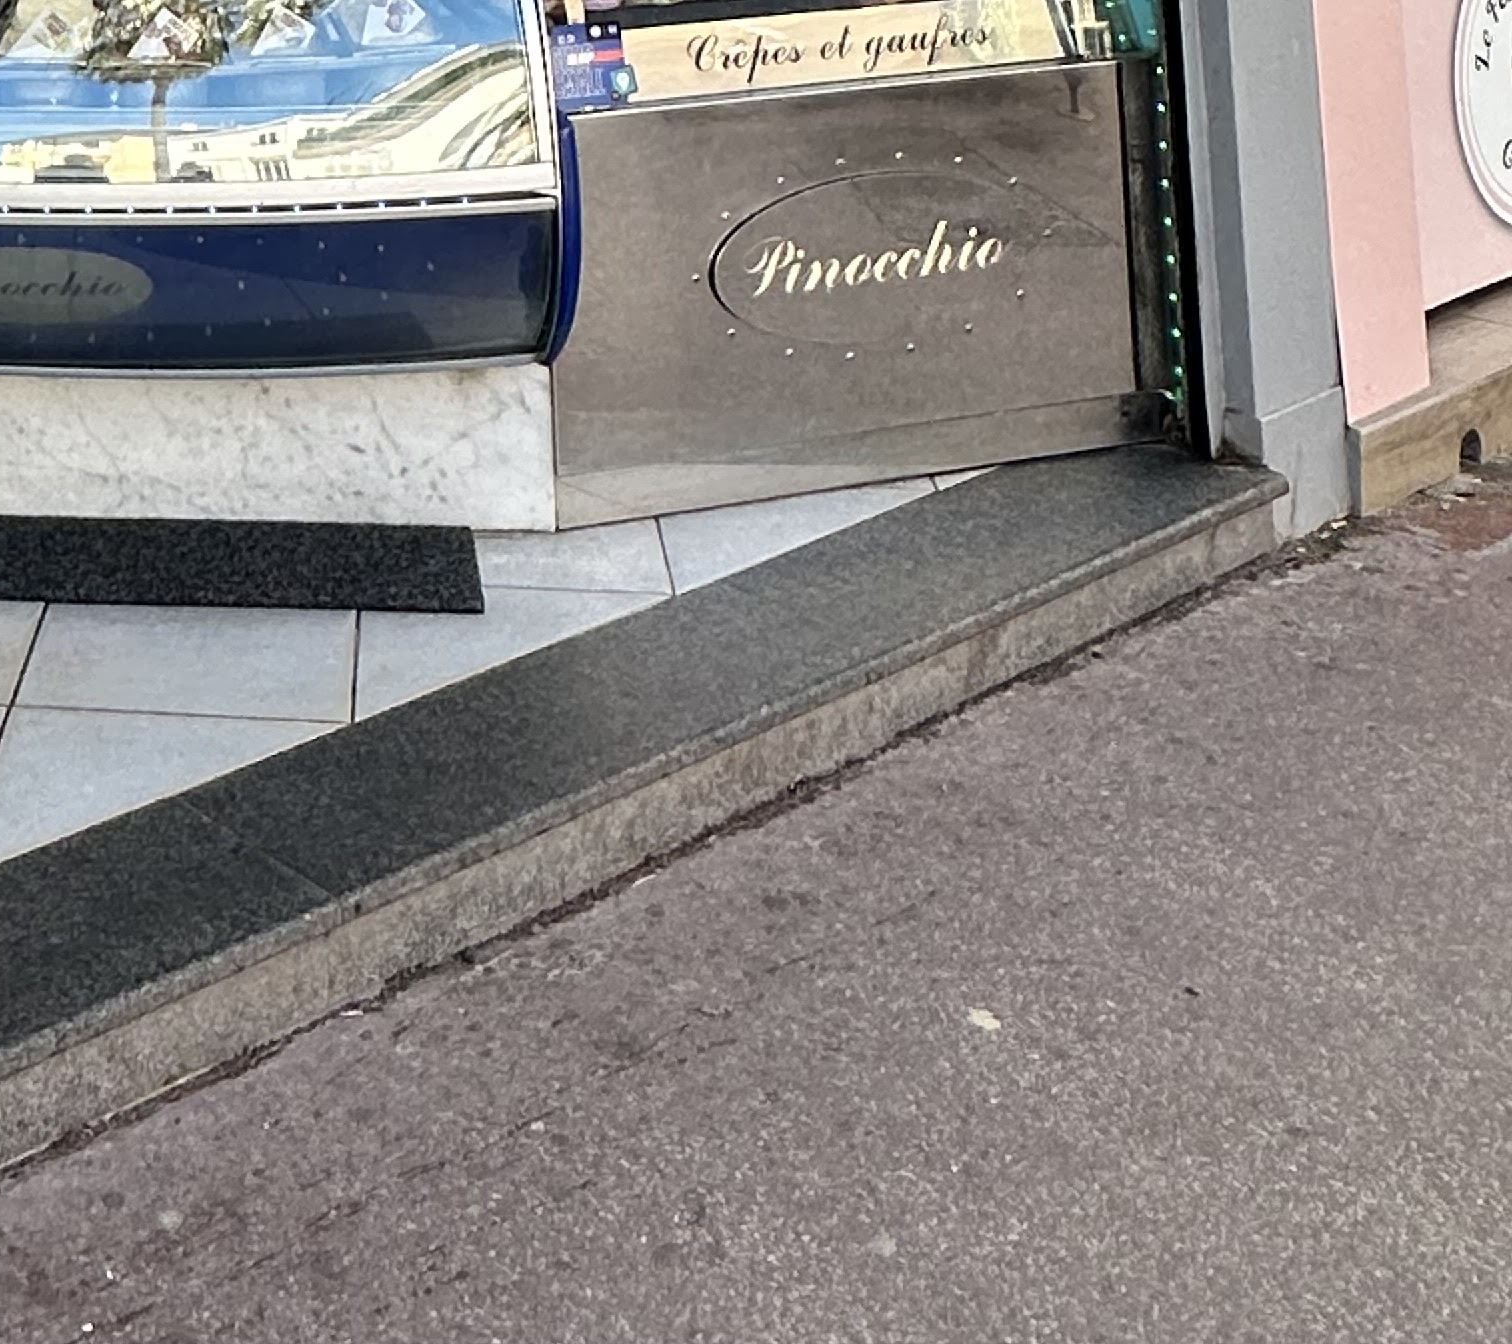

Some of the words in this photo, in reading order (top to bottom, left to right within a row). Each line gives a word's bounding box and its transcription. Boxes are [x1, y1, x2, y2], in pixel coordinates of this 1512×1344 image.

[687, 26, 806, 83] Crêpes
[819, 27, 852, 61] et
[863, 15, 991, 72] gaufres
[744, 219, 1011, 298] Pinocchio
